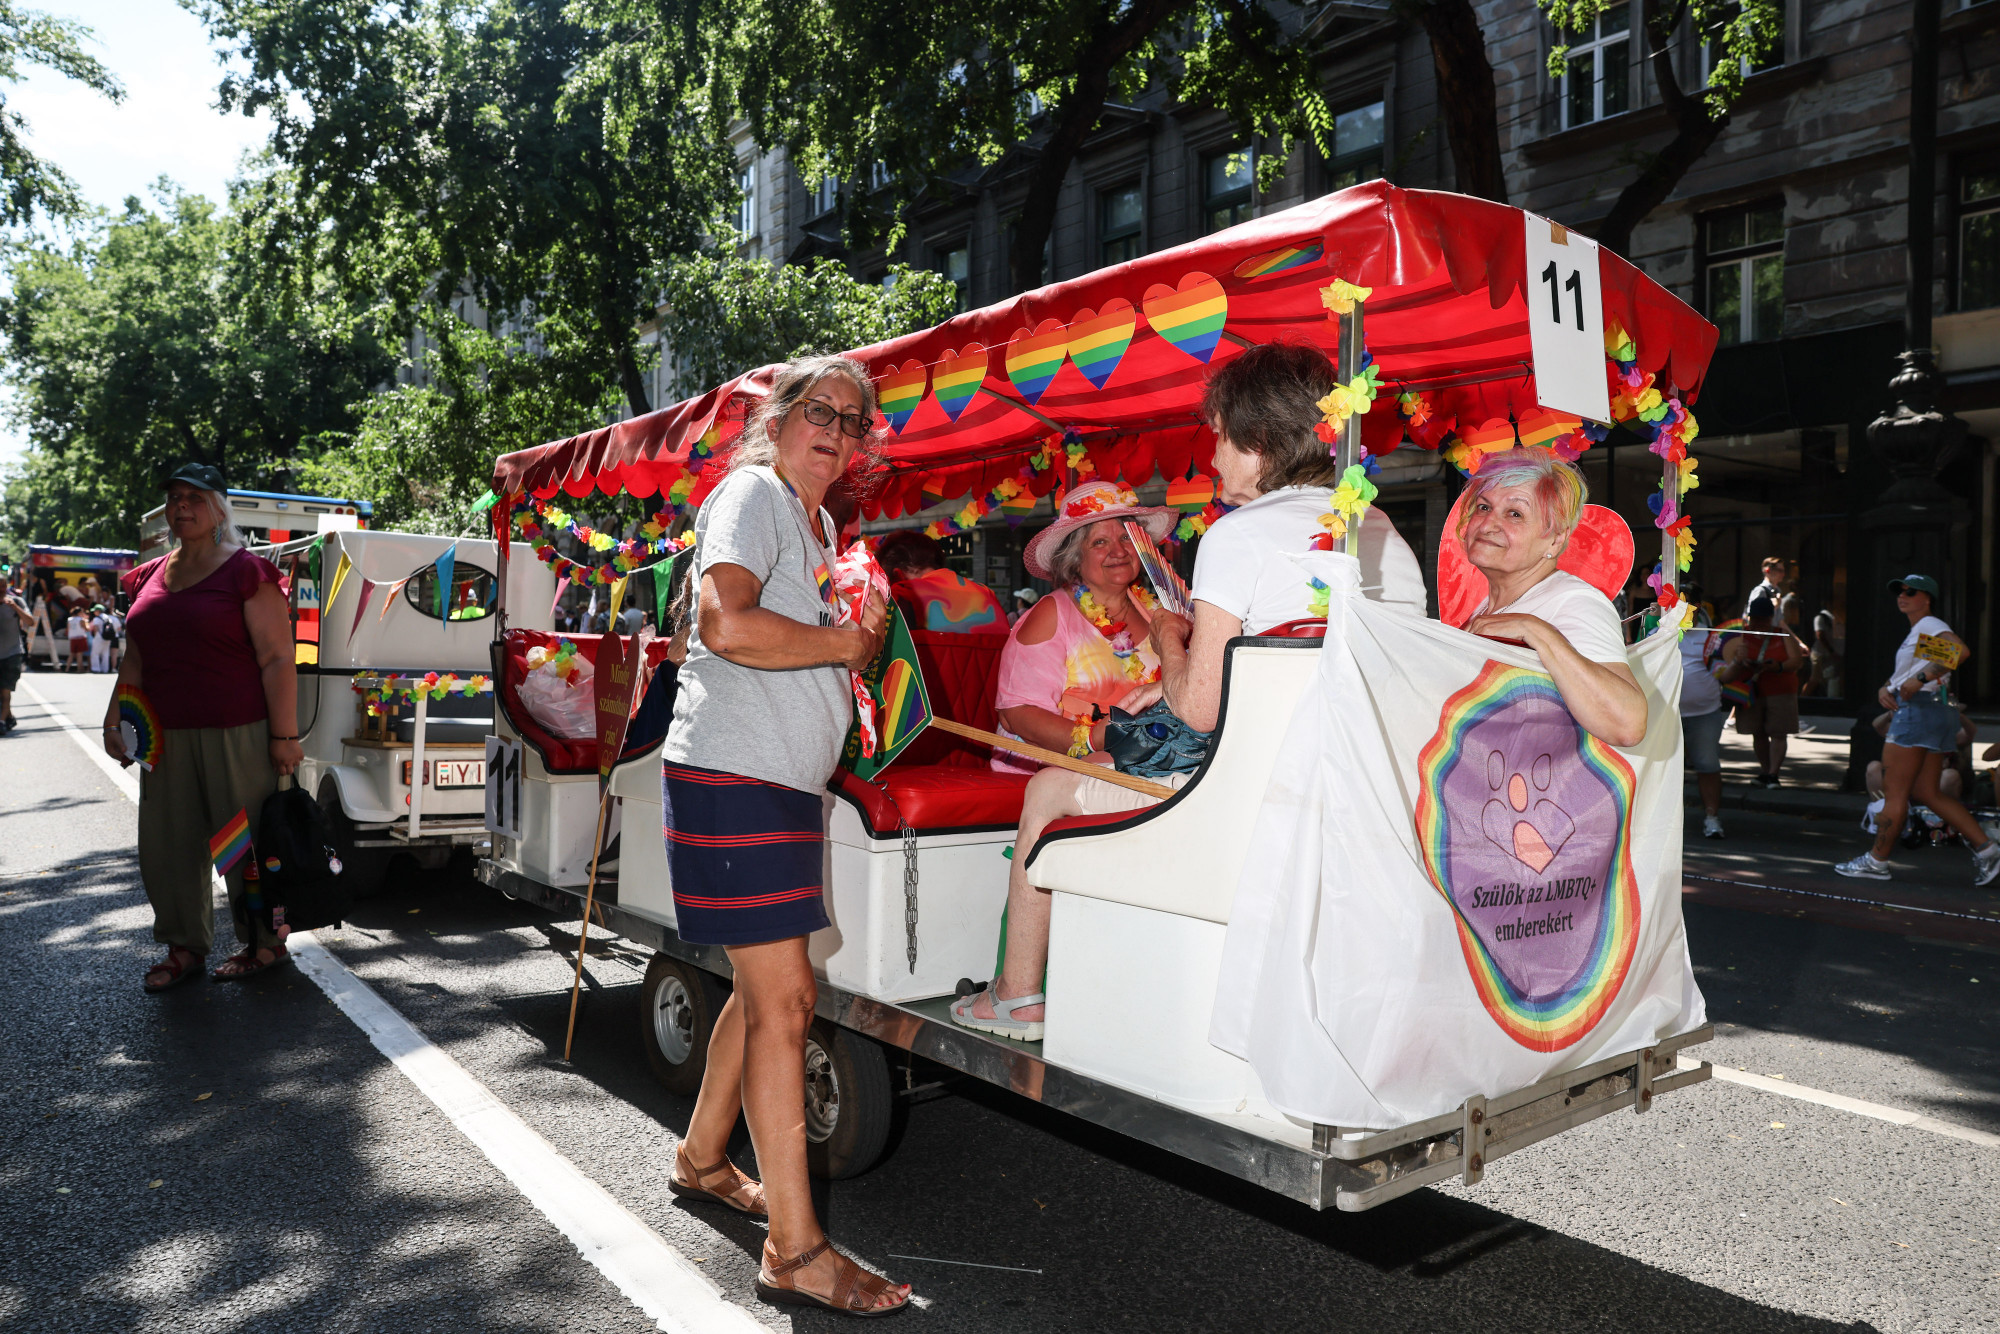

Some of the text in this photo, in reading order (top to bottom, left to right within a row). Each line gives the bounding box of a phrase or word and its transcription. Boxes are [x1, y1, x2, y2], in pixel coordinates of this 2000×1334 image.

[1541, 260, 1585, 332] 11
[488, 745, 520, 833] 11
[1471, 876, 1597, 909] Szülők az LMBTQ+
[1495, 910, 1574, 943] emberekért
